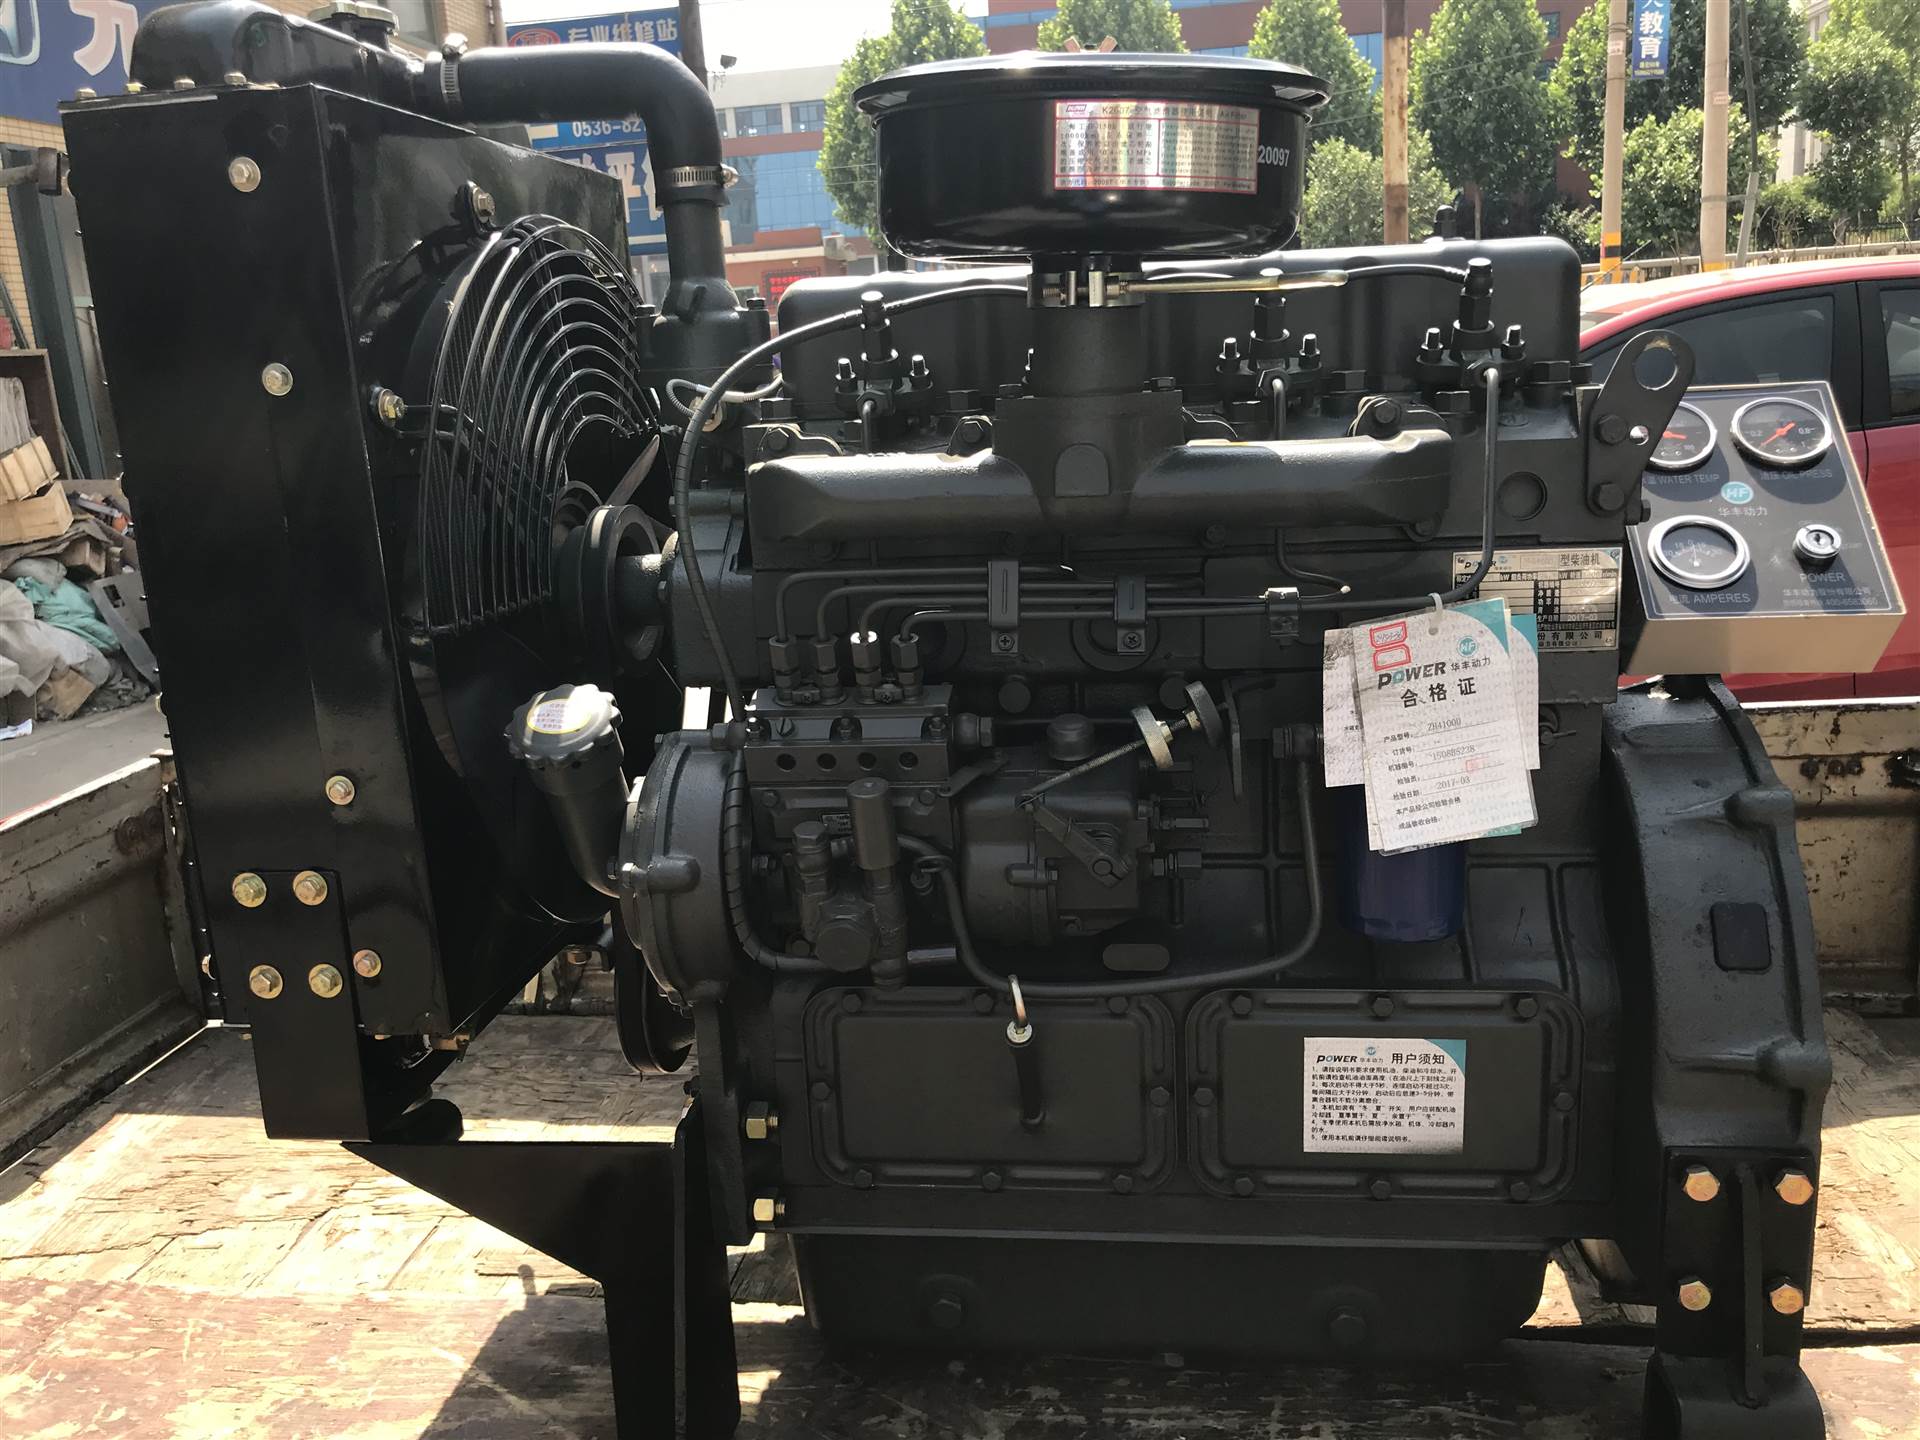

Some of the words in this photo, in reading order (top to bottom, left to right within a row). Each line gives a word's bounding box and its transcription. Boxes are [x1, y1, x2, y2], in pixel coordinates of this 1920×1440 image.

[572, 119, 646, 137] 0536-82
[1257, 145, 1290, 167] 20097
[1658, 474, 1692, 486] WATER
[1560, 552, 1601, 567] 型柴油机
[1799, 572, 1846, 583] POWER
[1693, 592, 1751, 605] AMPERES
[1450, 656, 1491, 671] 华丰动力
[1378, 661, 1446, 690] POWER
[1400, 676, 1477, 708] 合格证
[1316, 1055, 1358, 1064] POWER
[1391, 1053, 1446, 1066] 用户须知
